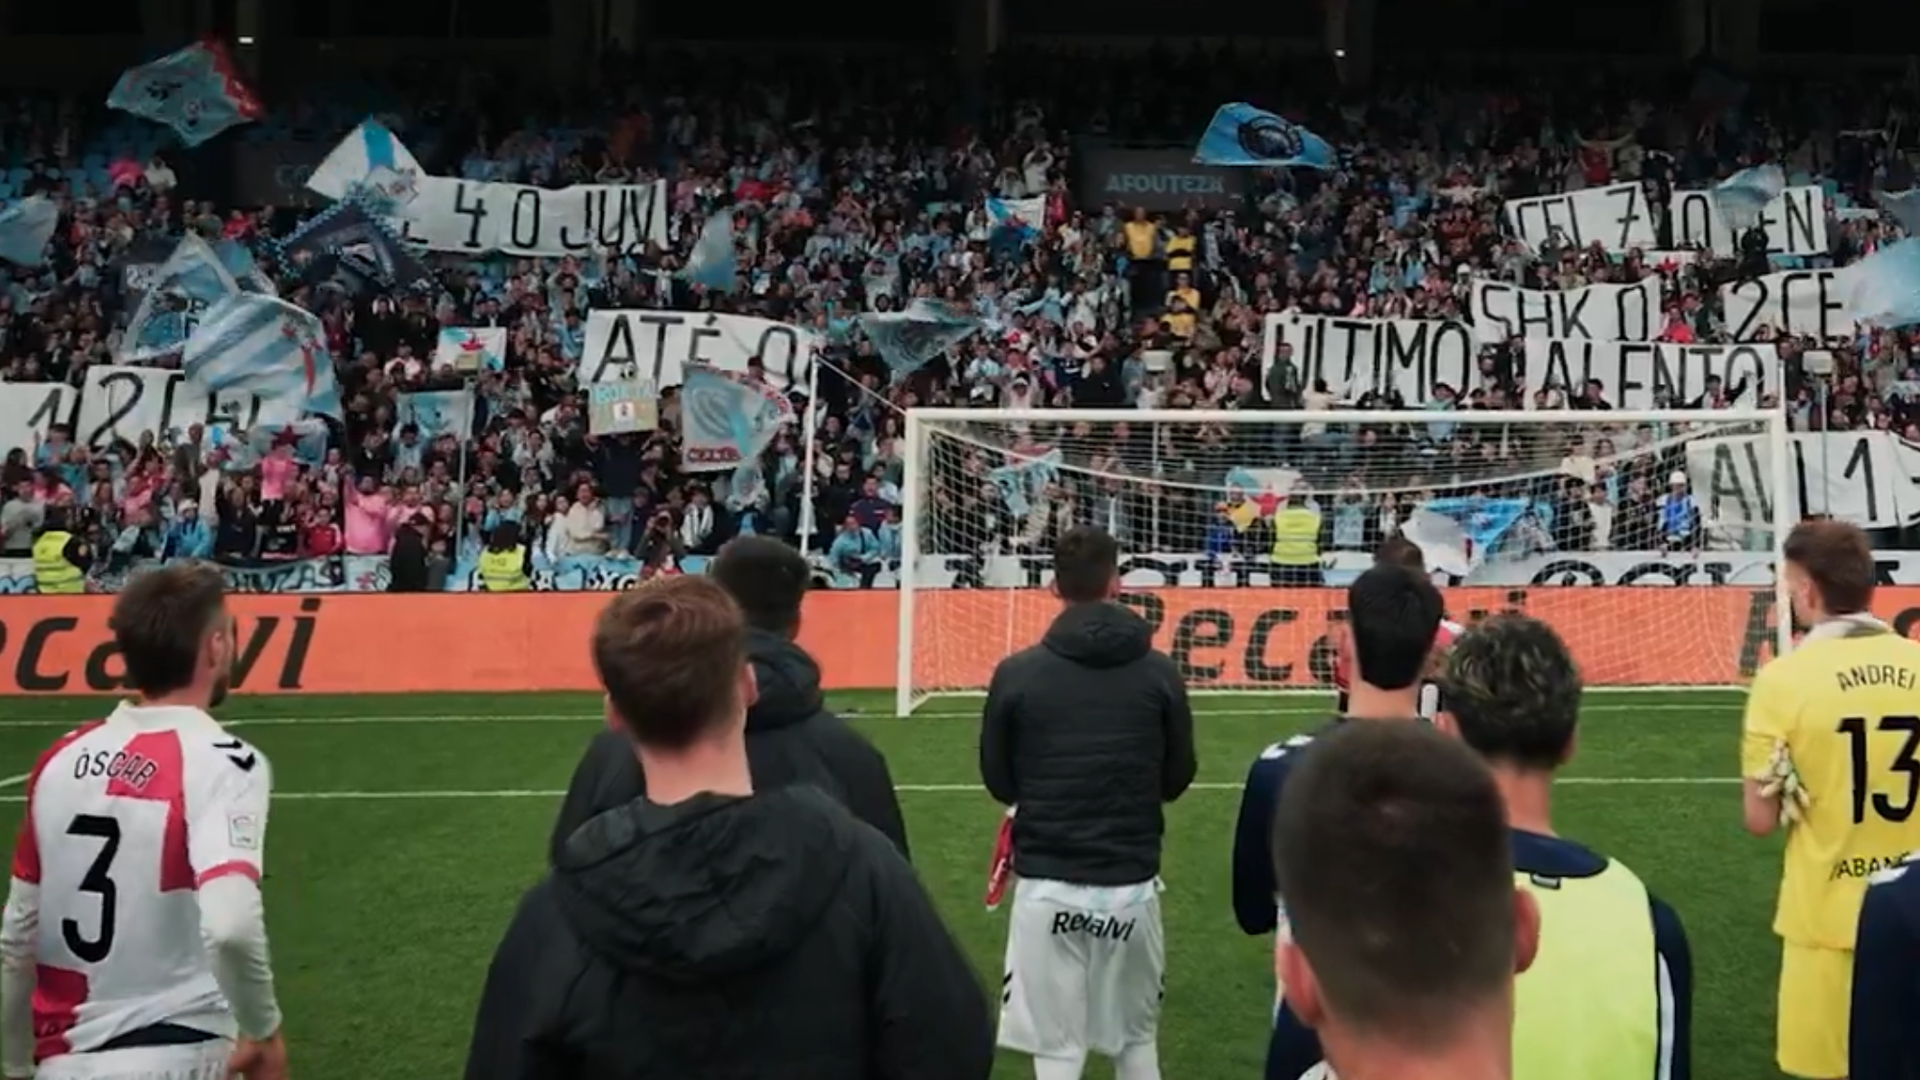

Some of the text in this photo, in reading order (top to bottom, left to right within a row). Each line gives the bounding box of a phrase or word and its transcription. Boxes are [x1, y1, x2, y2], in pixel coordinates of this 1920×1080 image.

[453, 183, 488, 248] 4
[1606, 185, 1640, 249] 7
[592, 312, 721, 393] ATÉ
[88, 371, 144, 453] 2
[1843, 437, 1877, 521] 1
[1836, 664, 1915, 692] ANDREI
[73, 746, 157, 789] ÓSCAR
[1836, 715, 1920, 825] 13
[62, 813, 122, 964] 3
[1051, 910, 1137, 943] Recalvi
